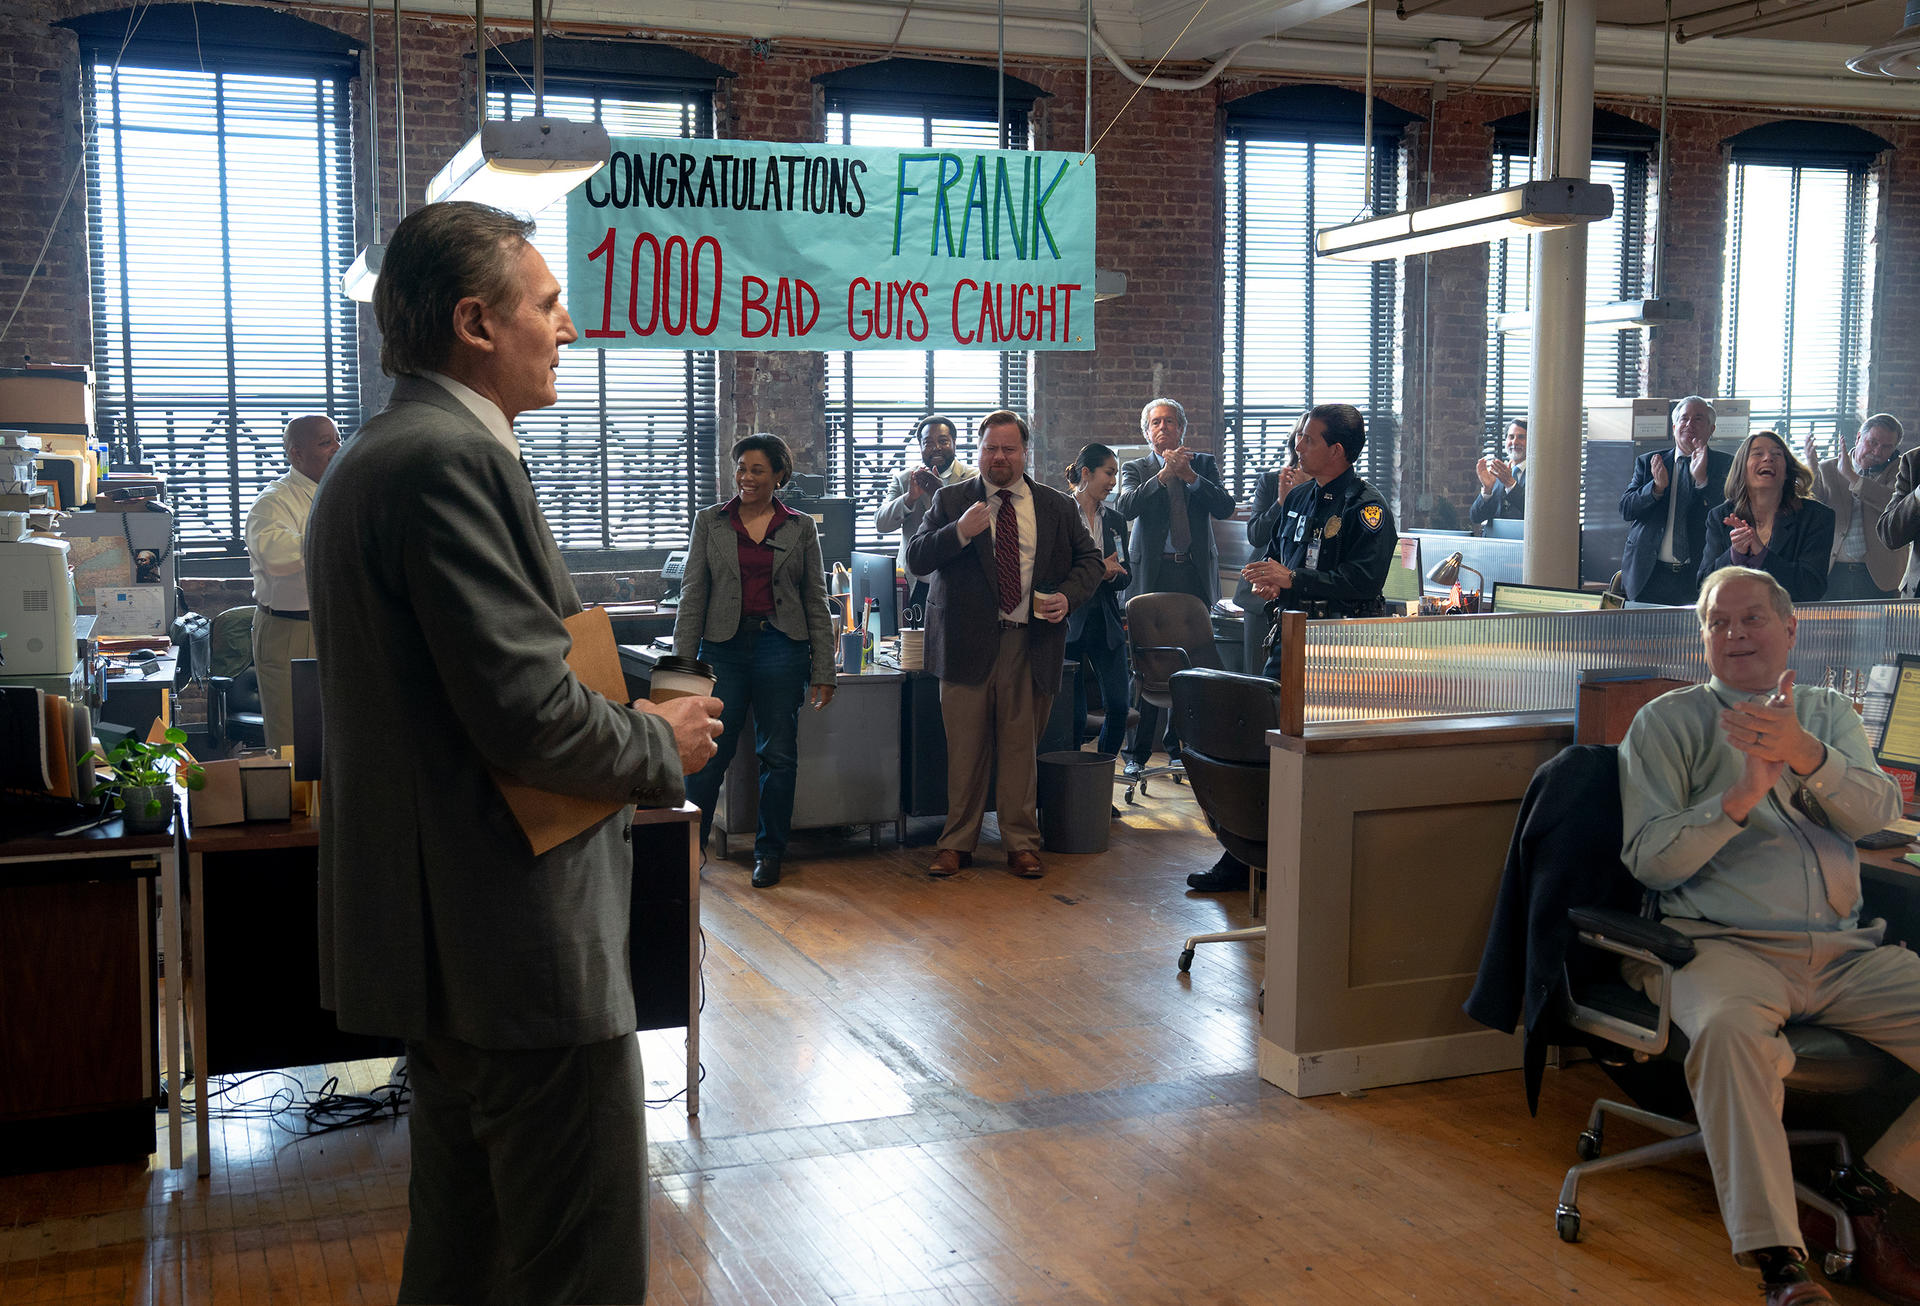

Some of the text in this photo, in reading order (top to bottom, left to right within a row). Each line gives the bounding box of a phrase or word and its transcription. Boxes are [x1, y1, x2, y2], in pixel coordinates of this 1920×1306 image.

[893, 152, 1070, 261] FRANK
[585, 227, 1081, 344] 1000 BAD GUYS CAUGHT
